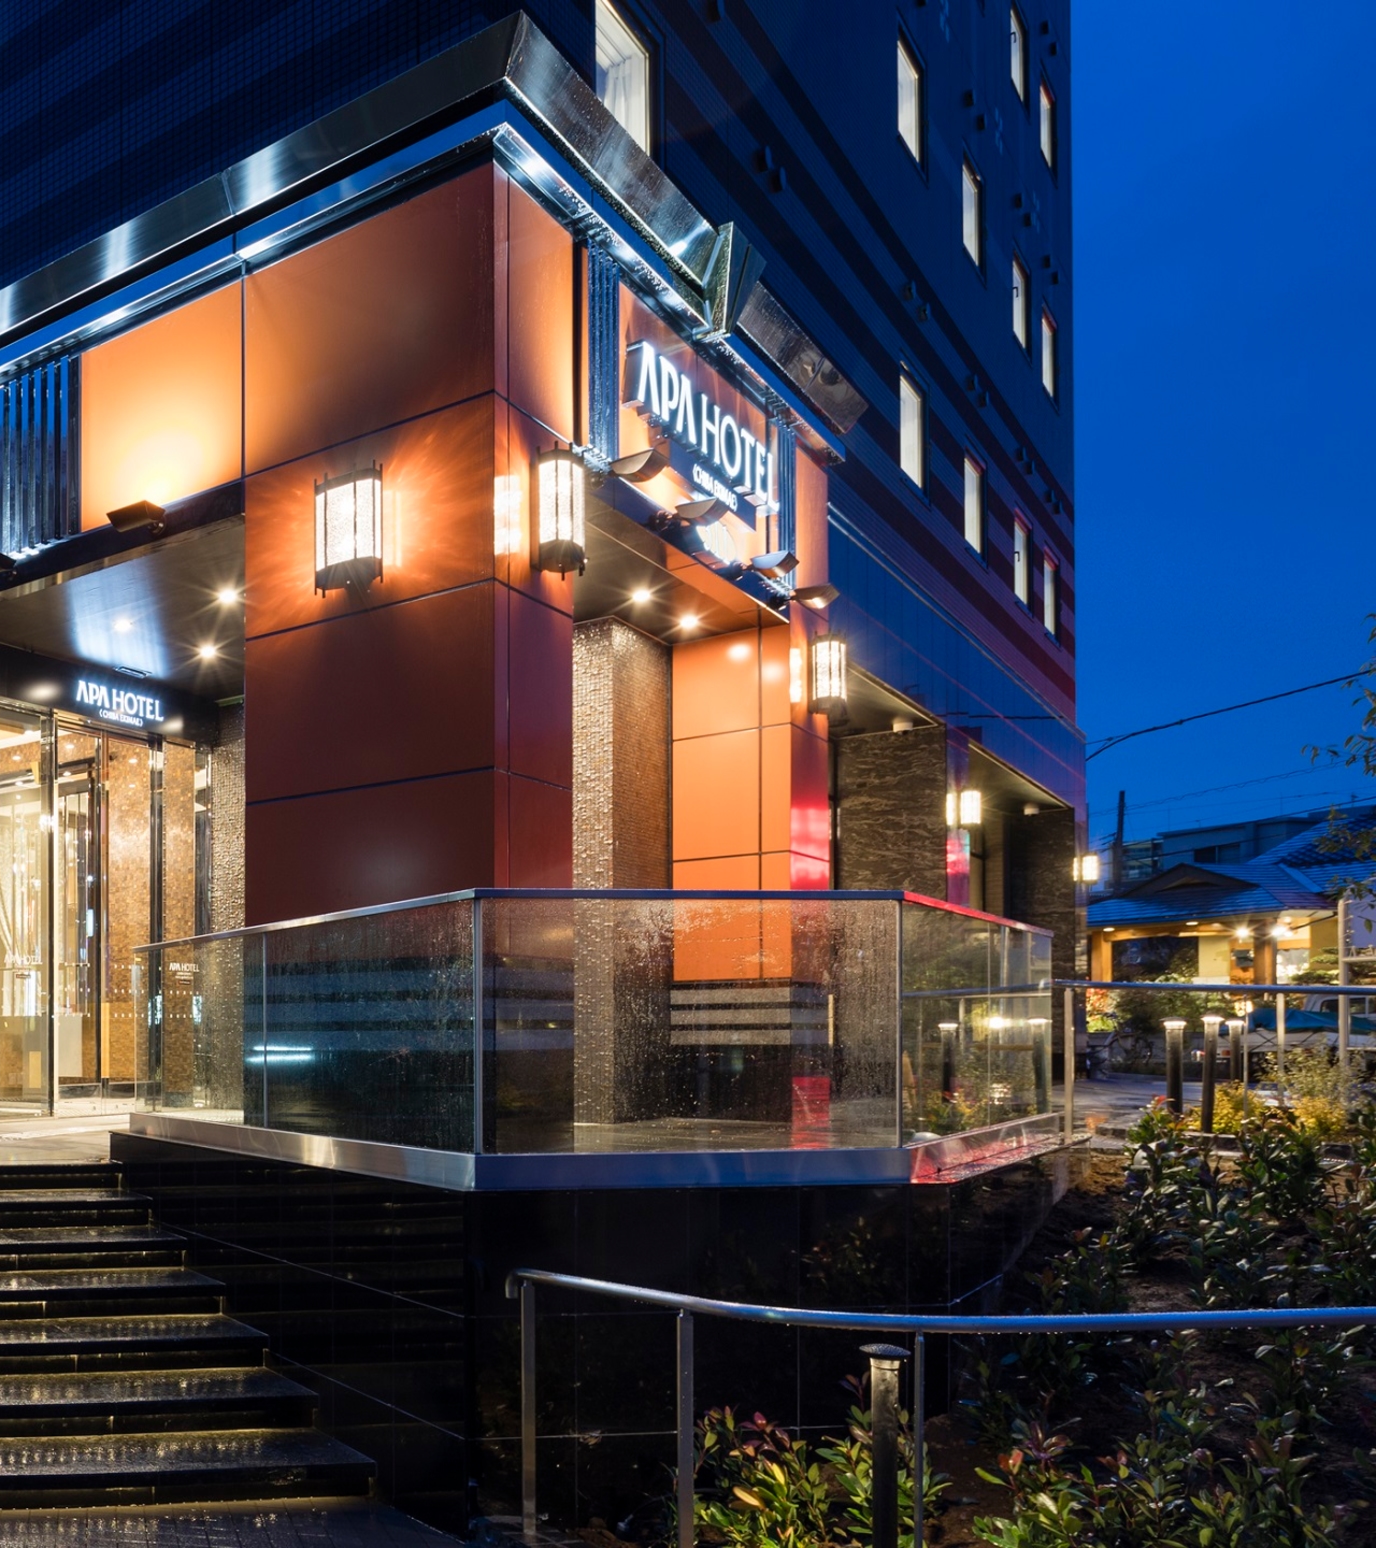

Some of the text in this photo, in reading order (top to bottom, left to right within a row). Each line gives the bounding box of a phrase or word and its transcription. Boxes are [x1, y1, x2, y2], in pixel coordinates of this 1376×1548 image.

[637, 340, 781, 514] APA HOTEL
[75, 679, 164, 722] APA HOTEL
